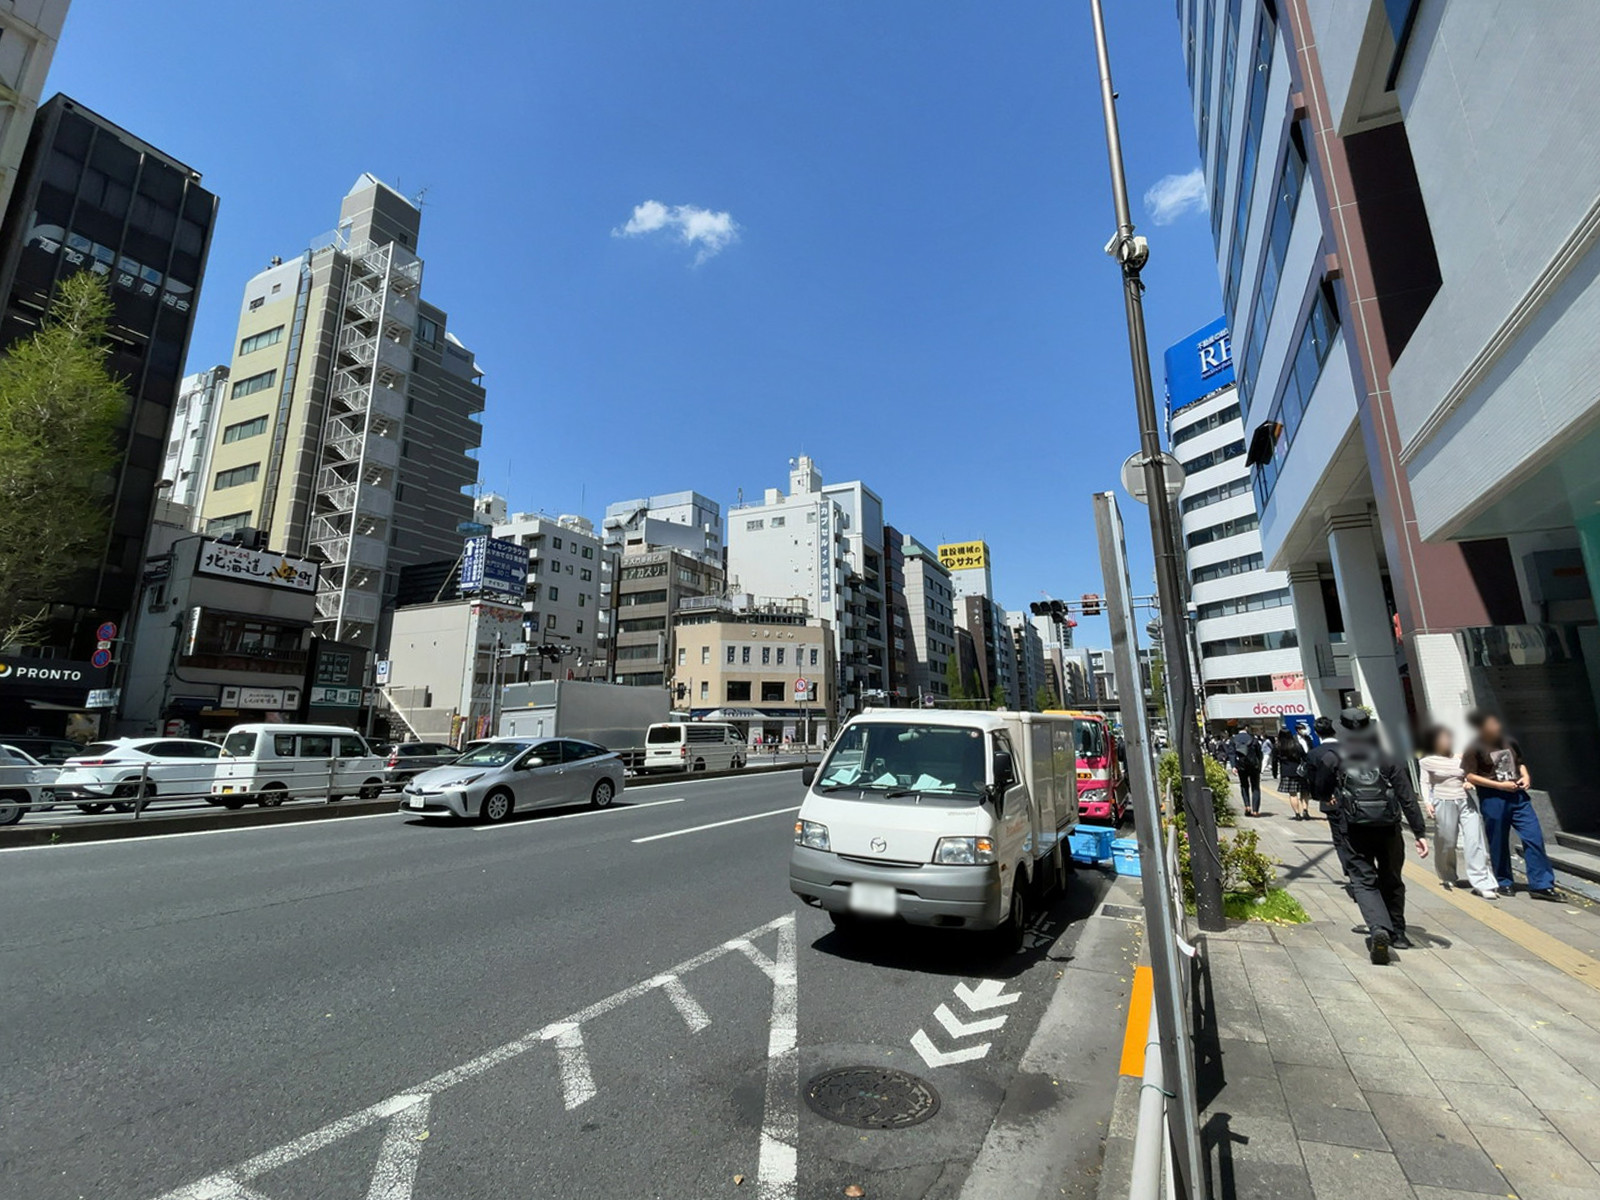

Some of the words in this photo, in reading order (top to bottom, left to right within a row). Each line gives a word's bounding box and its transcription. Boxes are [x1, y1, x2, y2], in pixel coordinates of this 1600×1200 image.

[941, 546, 981, 556] 建設機械の
[957, 556, 982, 566] サカイ
[16, 667, 81, 681] PRONTO
[1253, 703, 1305, 715] docomo
